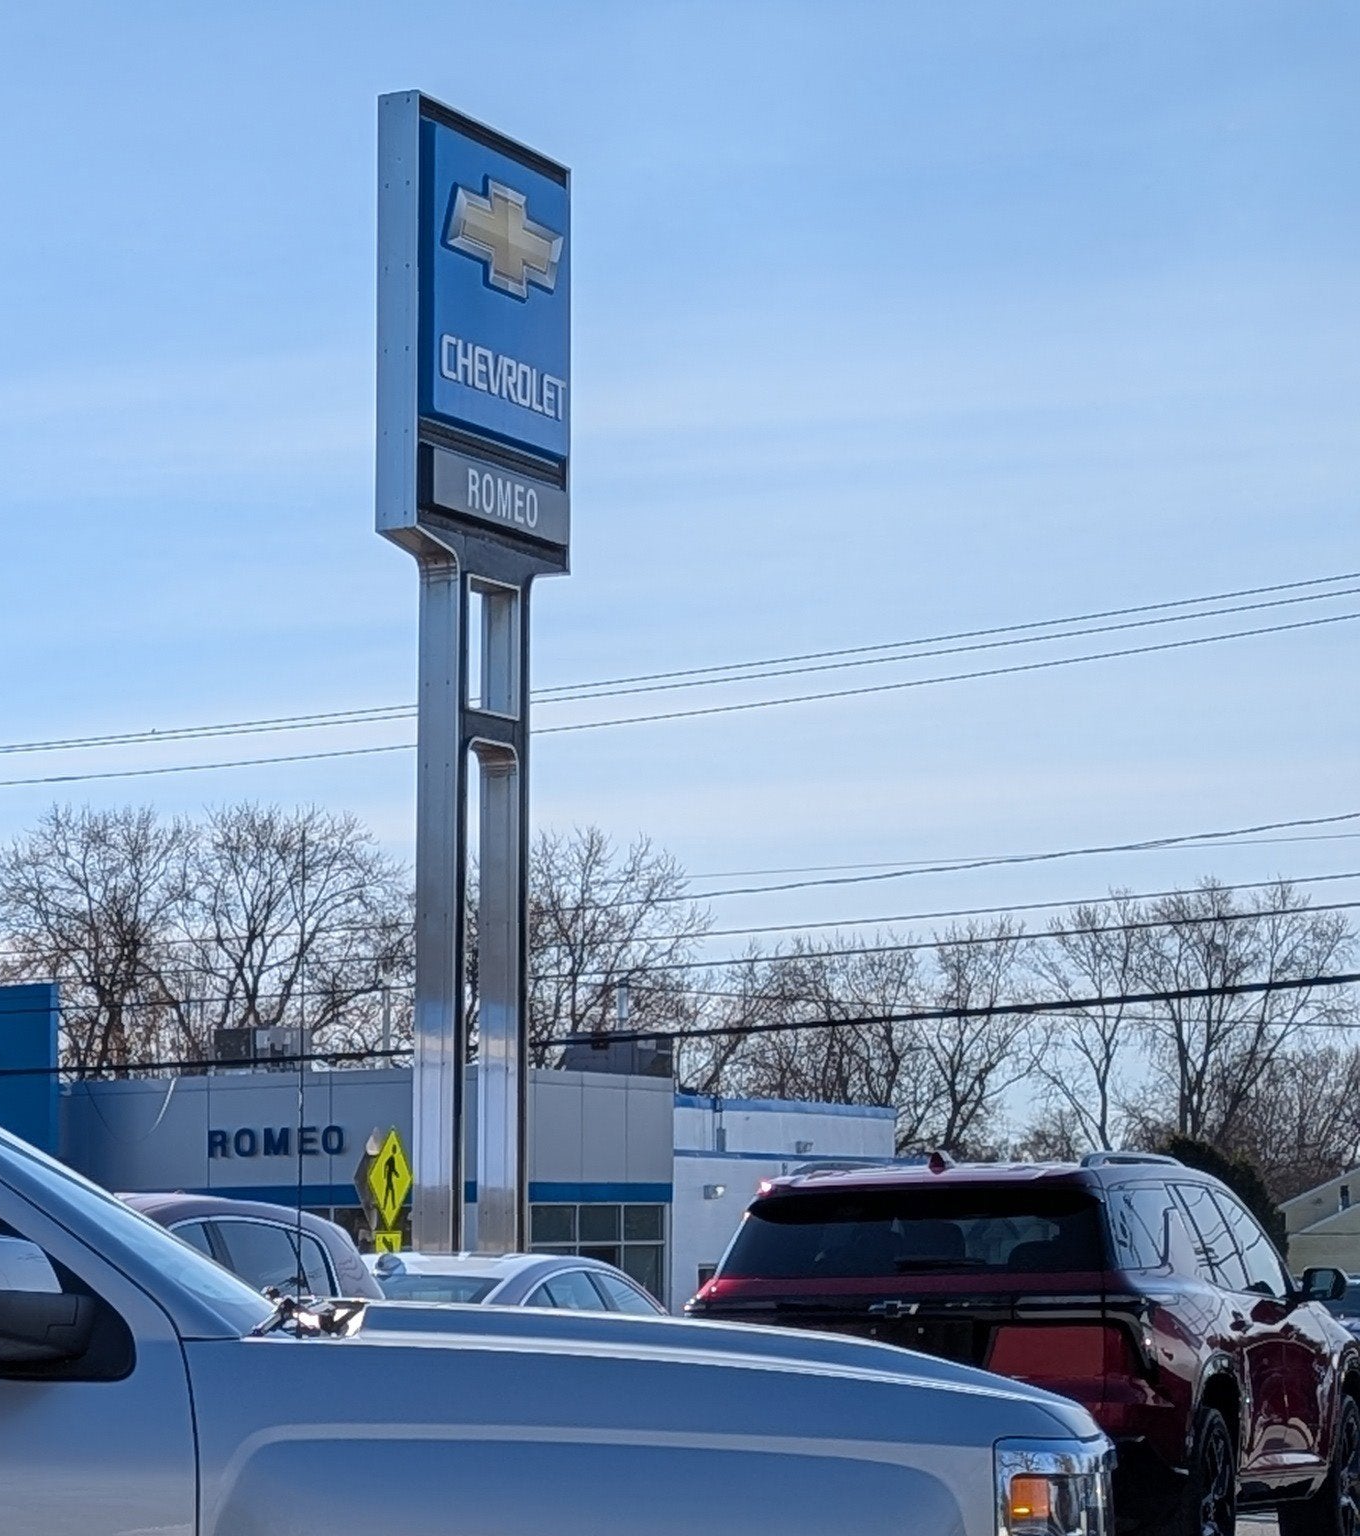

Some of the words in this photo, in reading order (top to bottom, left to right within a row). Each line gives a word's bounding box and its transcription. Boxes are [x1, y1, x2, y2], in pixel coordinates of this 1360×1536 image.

[441, 334, 567, 420] CHEVROLET
[468, 467, 539, 529] ROMEO
[207, 1125, 344, 1159] ROMEO
